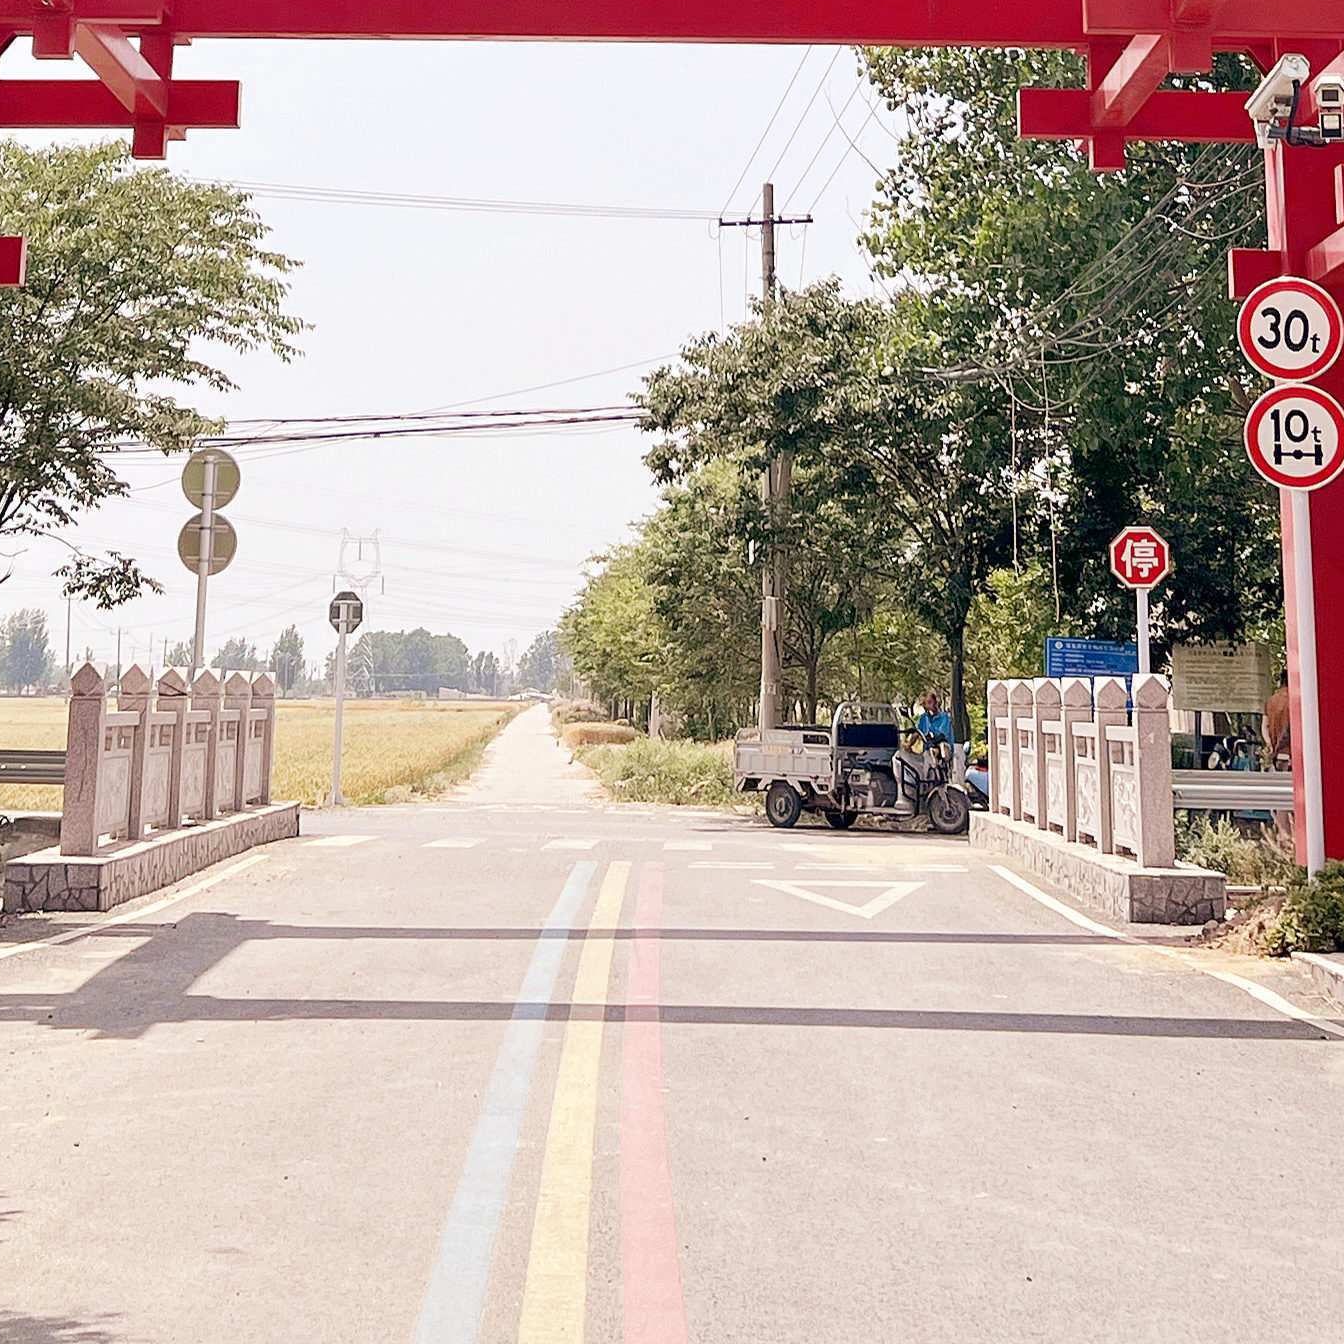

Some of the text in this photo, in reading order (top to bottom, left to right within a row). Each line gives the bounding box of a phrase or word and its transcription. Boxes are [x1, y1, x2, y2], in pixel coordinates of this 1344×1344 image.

[1257, 307, 1320, 354] 30t
[1270, 409, 1322, 443] 10t
[1120, 538, 1159, 578] 停
